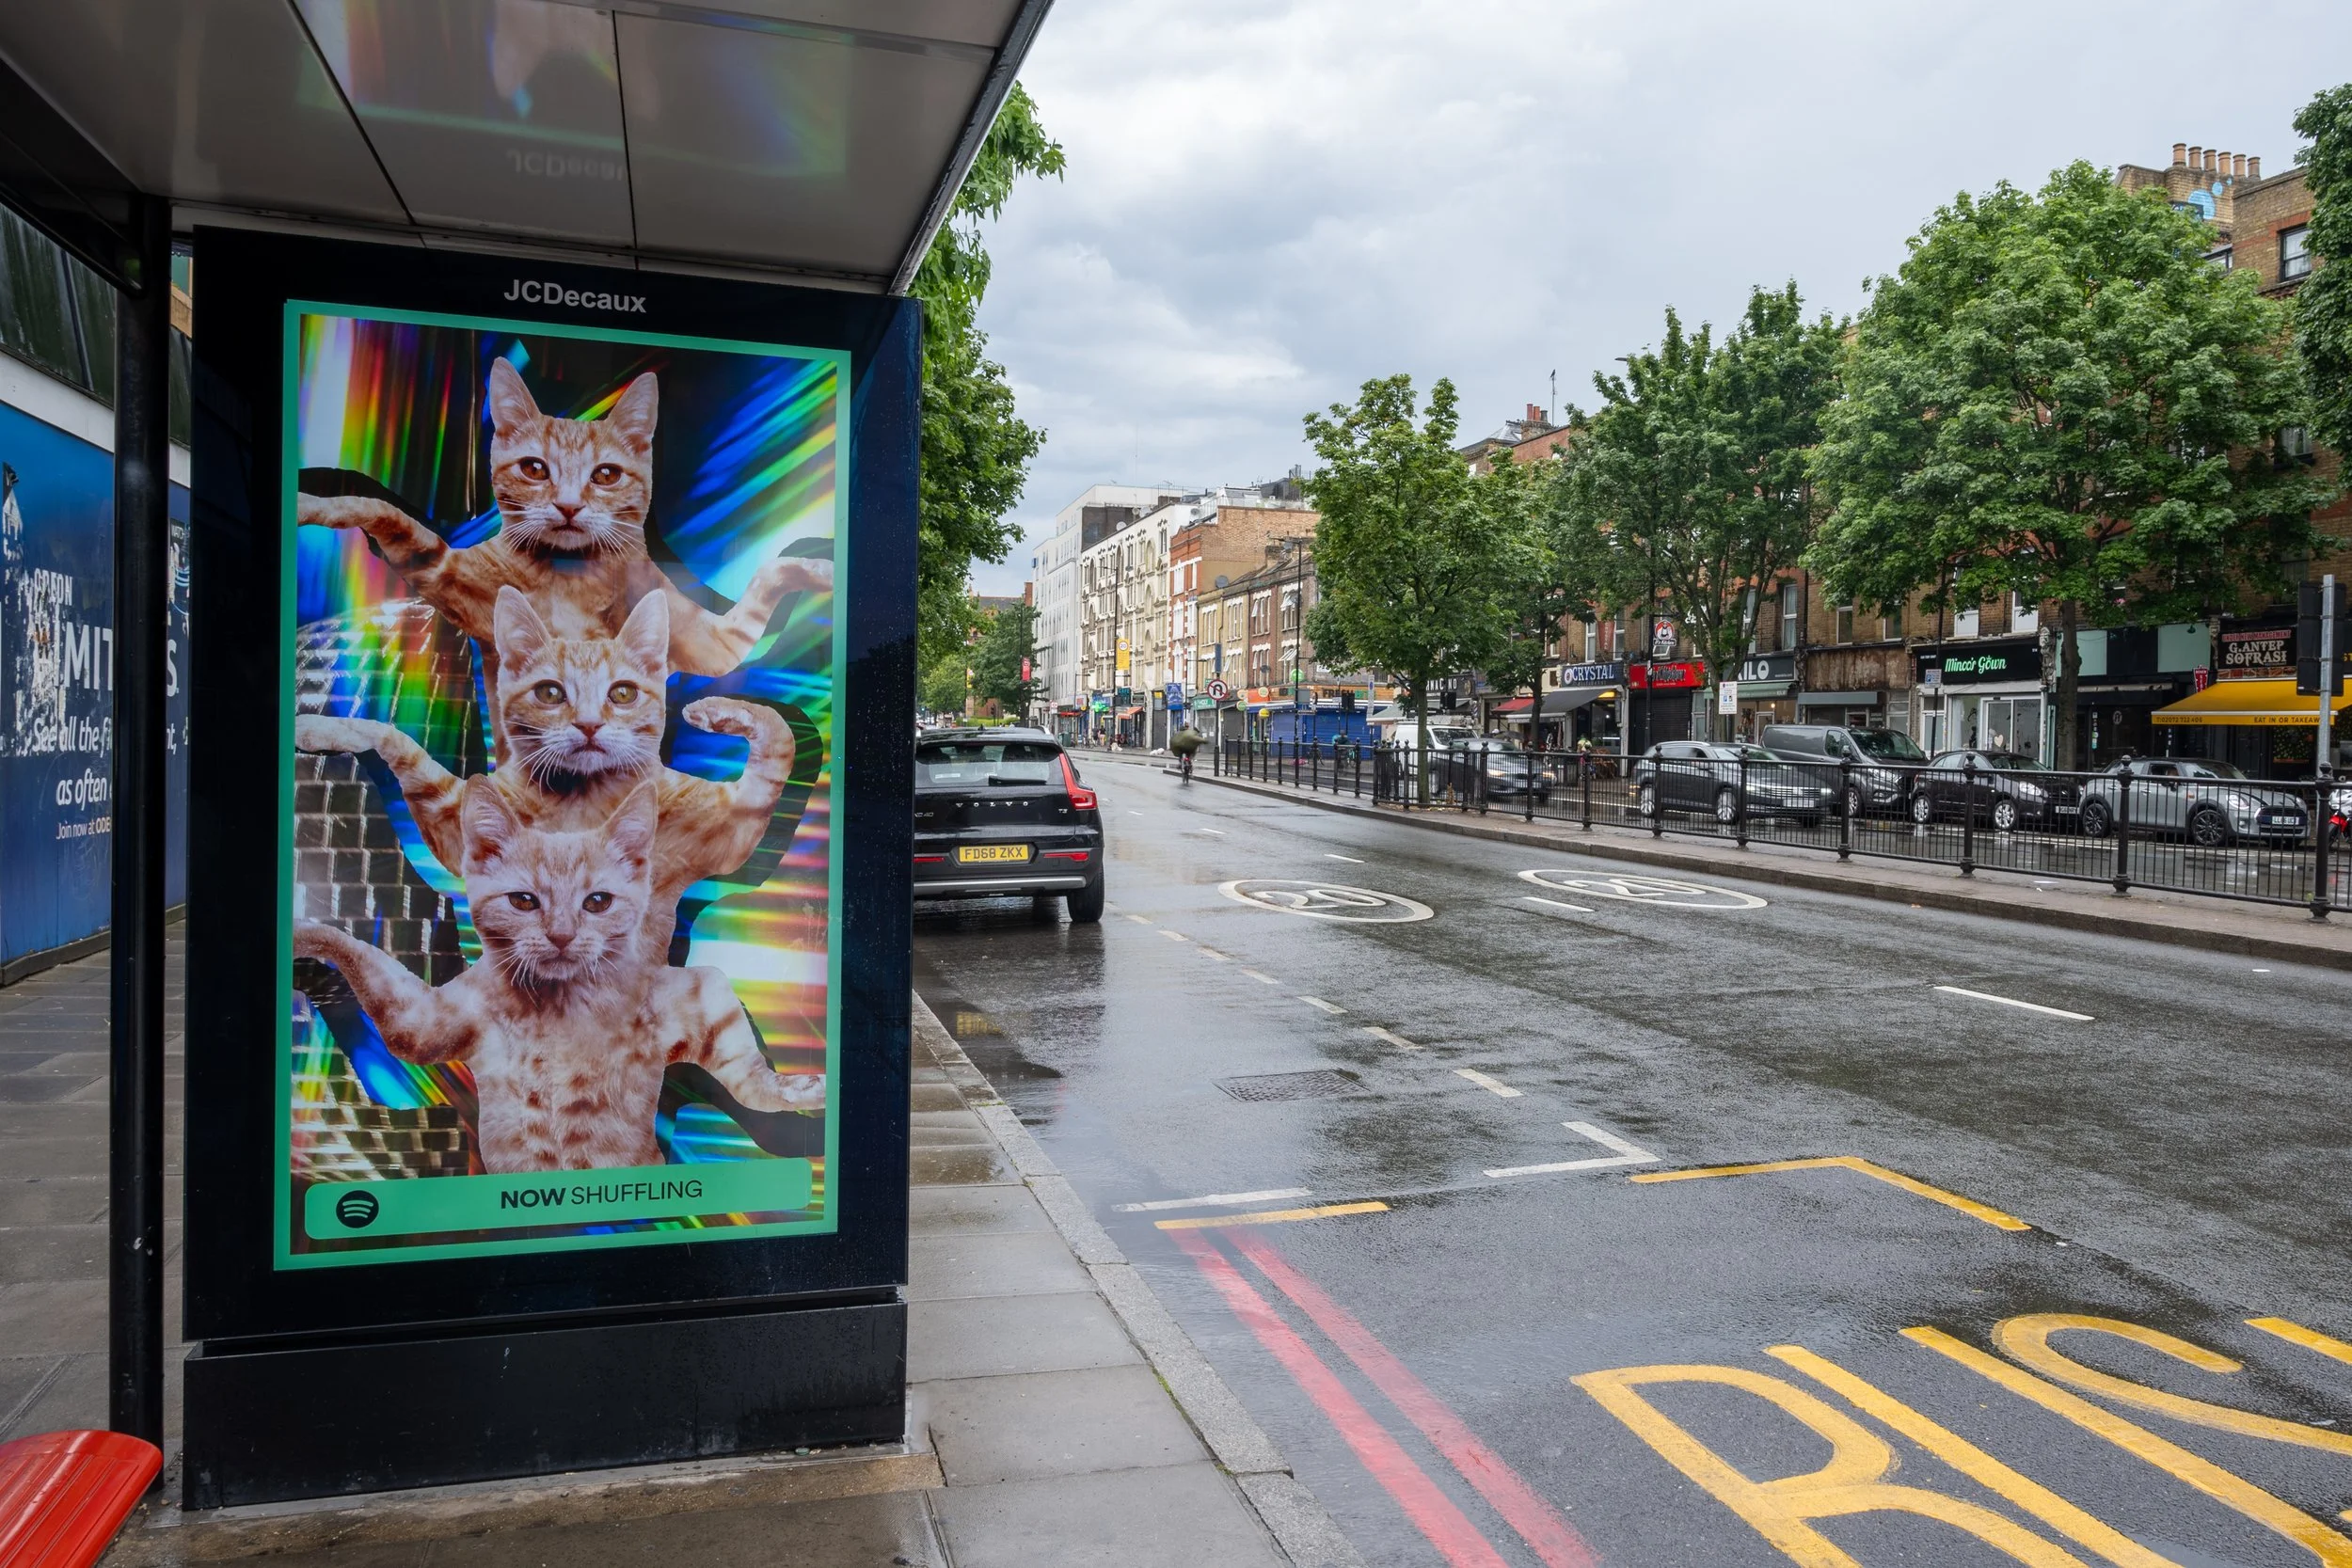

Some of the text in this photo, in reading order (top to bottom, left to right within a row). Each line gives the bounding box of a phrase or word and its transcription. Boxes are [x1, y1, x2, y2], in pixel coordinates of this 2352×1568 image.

[503, 279, 646, 313] JCDecaux
[2229, 641, 2284, 653] G.ANTEP
[1978, 656, 2007, 674] Gown
[2226, 651, 2287, 666] SOFRASI
[1572, 664, 1614, 681] CRYSTAL
[1738, 660, 1769, 682] ILO
[59, 716, 76, 752] all
[78, 717, 99, 752] the
[56, 768, 107, 811] as often
[56, 820, 72, 839] Join
[72, 823, 87, 837] now
[88, 820, 95, 834] at
[1000, 847, 1023, 858] ZKX
[1254, 889, 1386, 909] 20
[501, 1180, 703, 1210] NOW SHUFFLING
